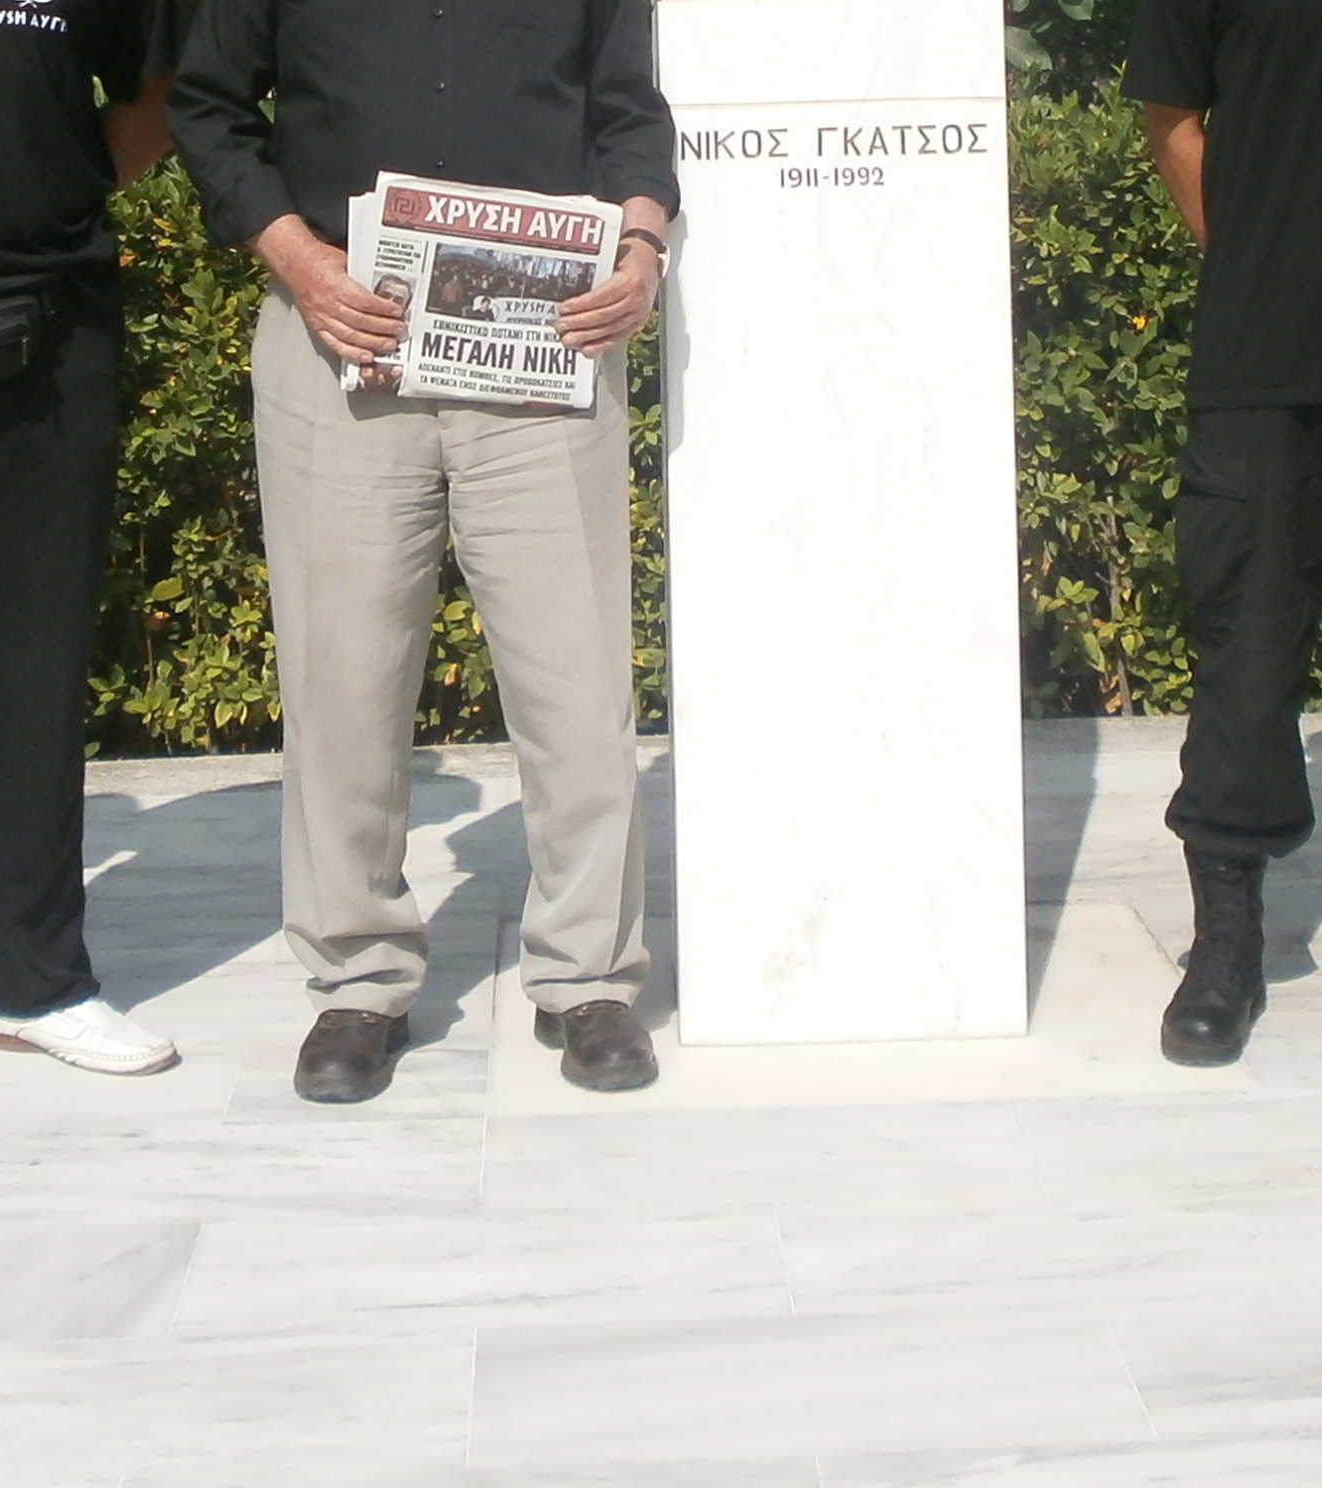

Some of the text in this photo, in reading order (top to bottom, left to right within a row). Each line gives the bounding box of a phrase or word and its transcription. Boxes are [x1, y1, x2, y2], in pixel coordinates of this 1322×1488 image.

[679, 123, 989, 161] ΝΙΚΟΣ ΓΚΑΤΣΟΣ
[780, 166, 885, 189] 1911-1992
[424, 195, 603, 245] ΧΡΥΣΗ ΑΥΓΗ
[421, 332, 577, 376] ΜΕΓΑΛΗ ΝΙΚΗ
